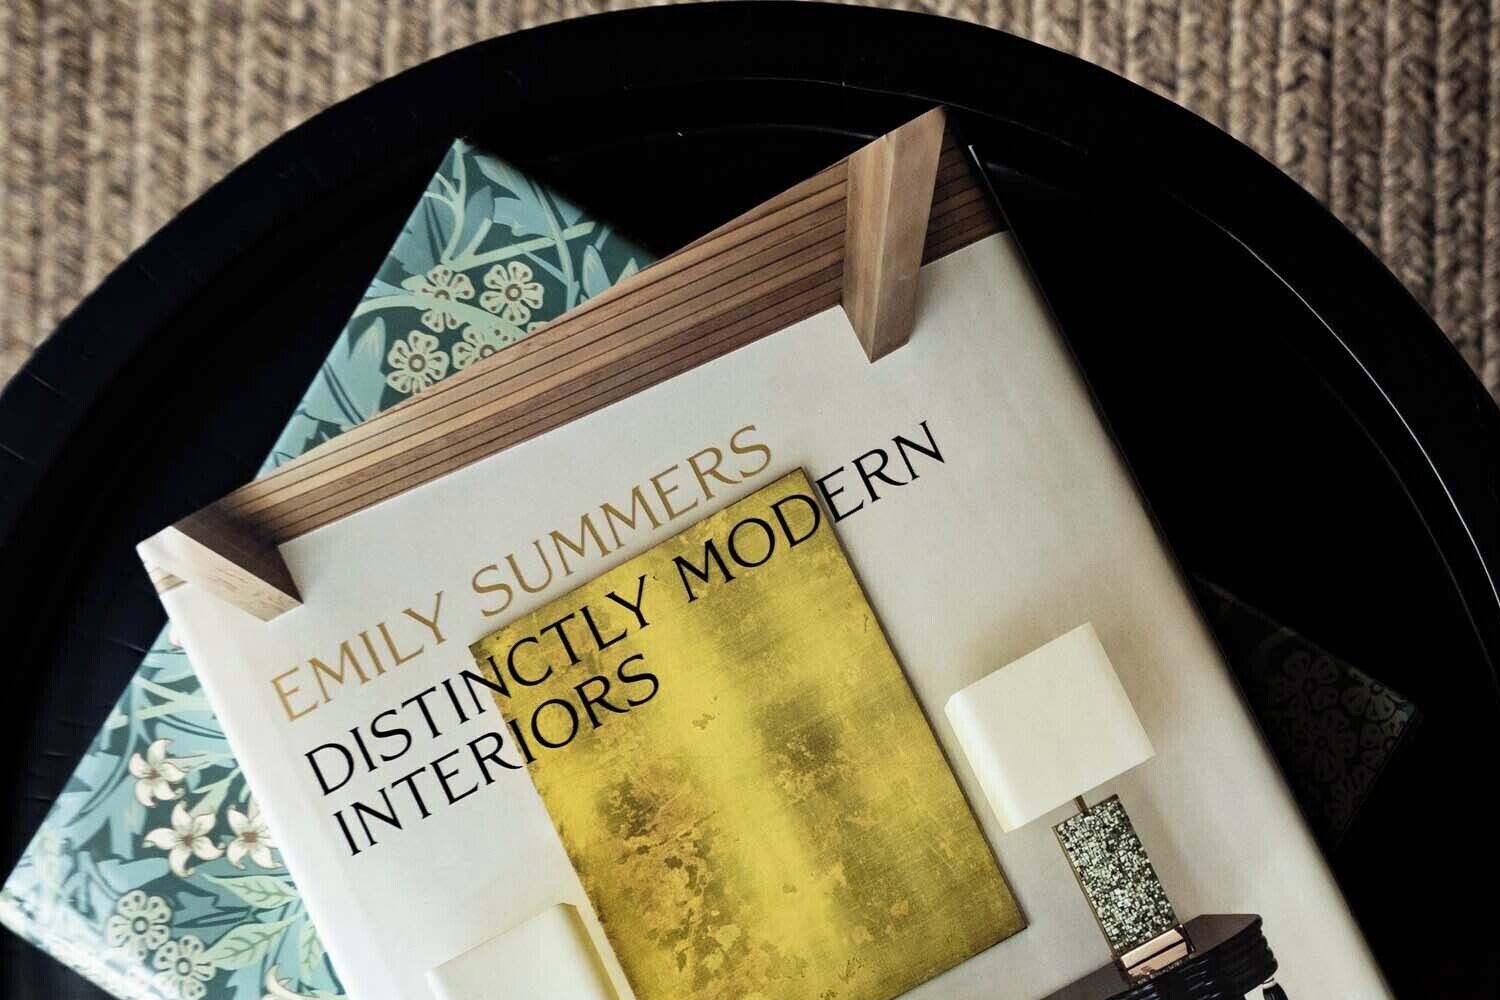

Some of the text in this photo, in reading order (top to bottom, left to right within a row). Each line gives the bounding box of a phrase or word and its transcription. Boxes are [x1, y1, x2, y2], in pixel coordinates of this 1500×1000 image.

[270, 424, 773, 722] EMILY SUMMERS
[304, 420, 946, 796] DISTINCTLY MODERN
[333, 653, 659, 857] INTERIORS
